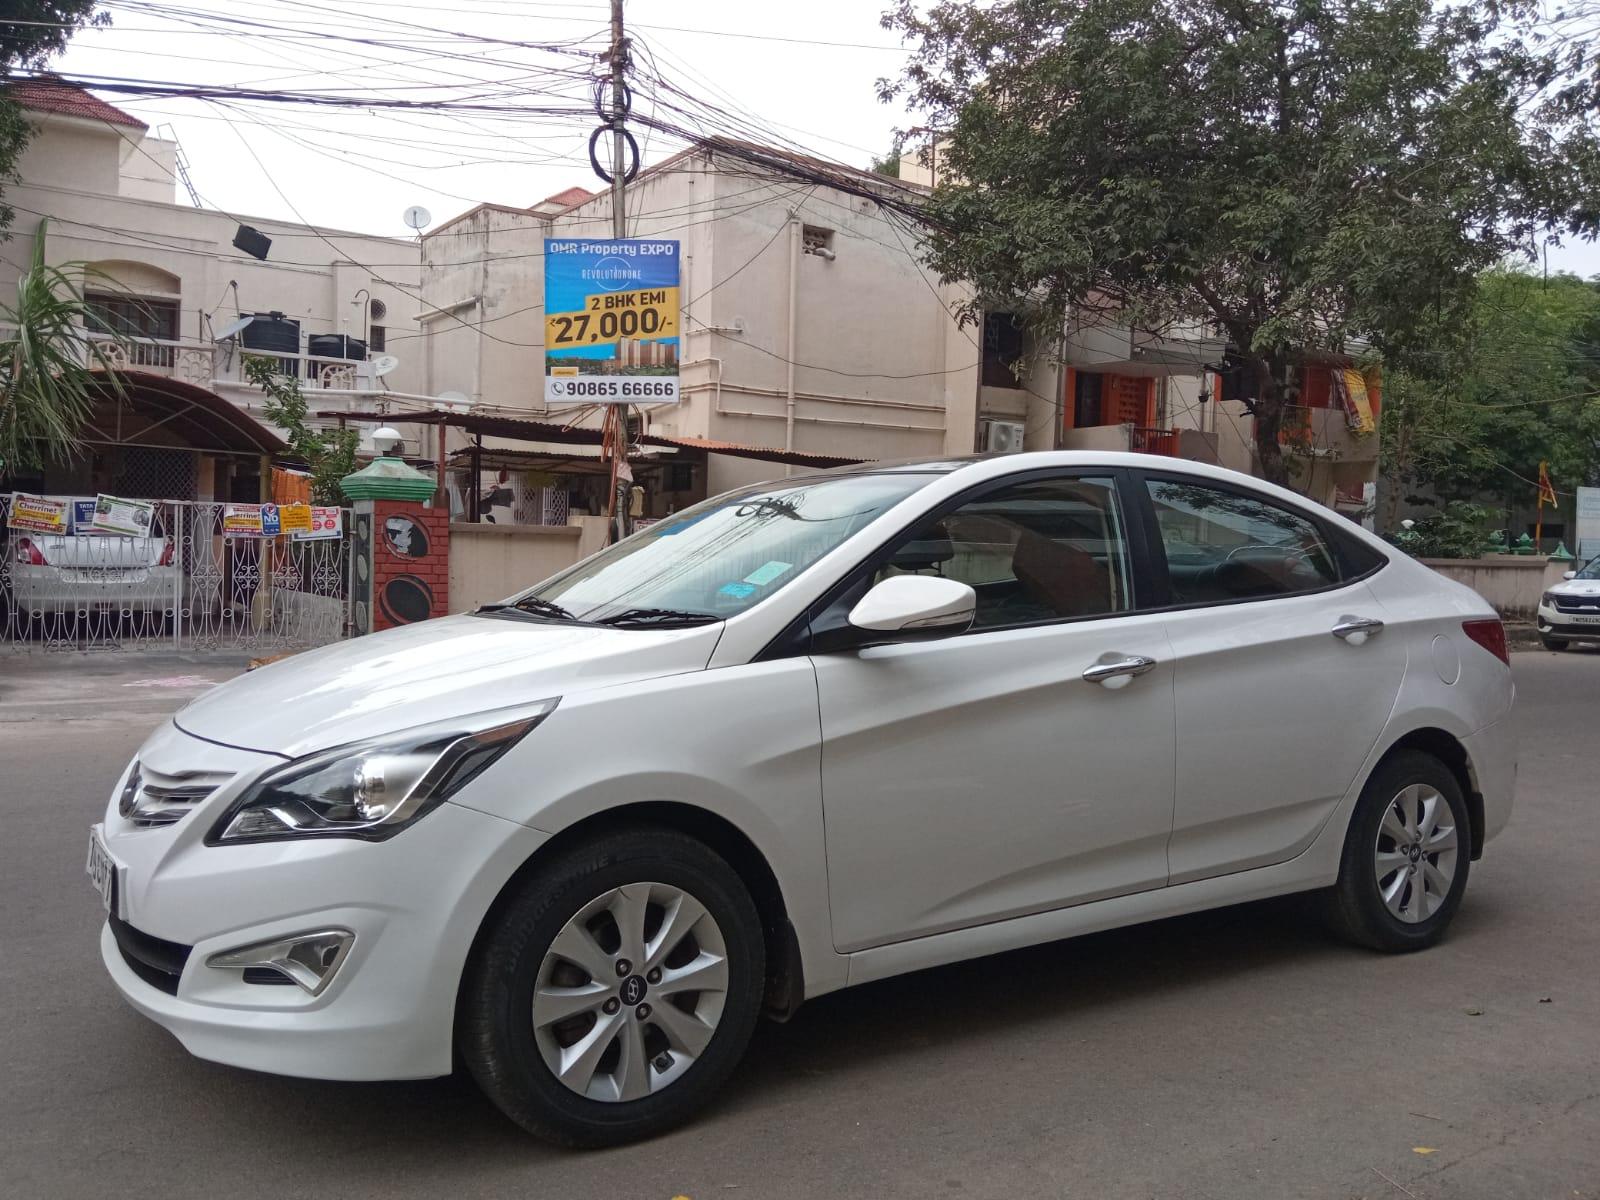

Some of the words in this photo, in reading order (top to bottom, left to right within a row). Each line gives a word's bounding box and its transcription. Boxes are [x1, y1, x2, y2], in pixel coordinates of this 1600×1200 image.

[550, 242, 578, 255] OMR
[581, 243, 637, 257] Property
[640, 243, 674, 256] EXPO
[591, 297, 601, 311] 2
[605, 293, 636, 309] BHK
[640, 290, 666, 306] EMI
[566, 381, 618, 396] 90865
[622, 381, 674, 396] 66666
